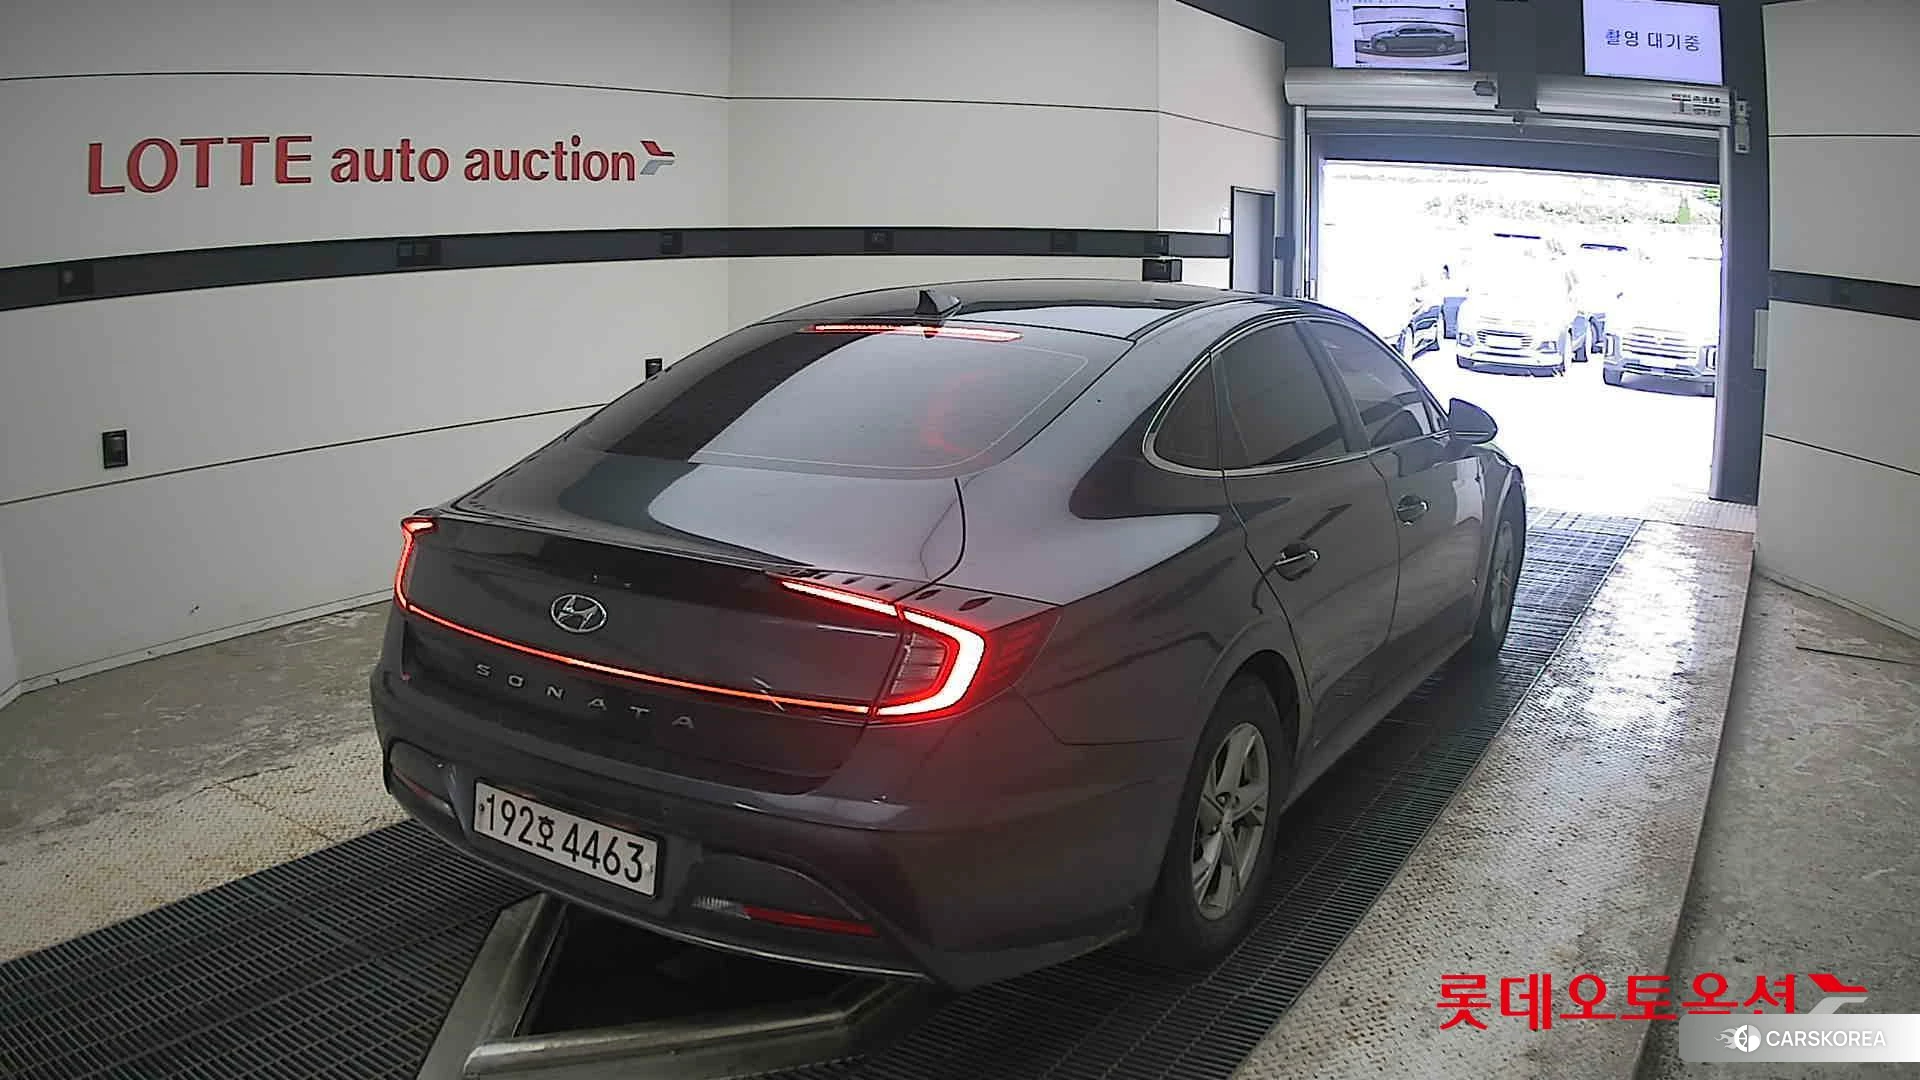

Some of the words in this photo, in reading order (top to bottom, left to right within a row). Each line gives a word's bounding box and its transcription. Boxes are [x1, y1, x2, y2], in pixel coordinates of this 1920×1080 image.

[1647, 32, 1701, 52] 대기중
[88, 135, 312, 195] LOTTE
[330, 137, 450, 184] auto
[463, 134, 637, 183] auction
[476, 663, 695, 729] SONATA
